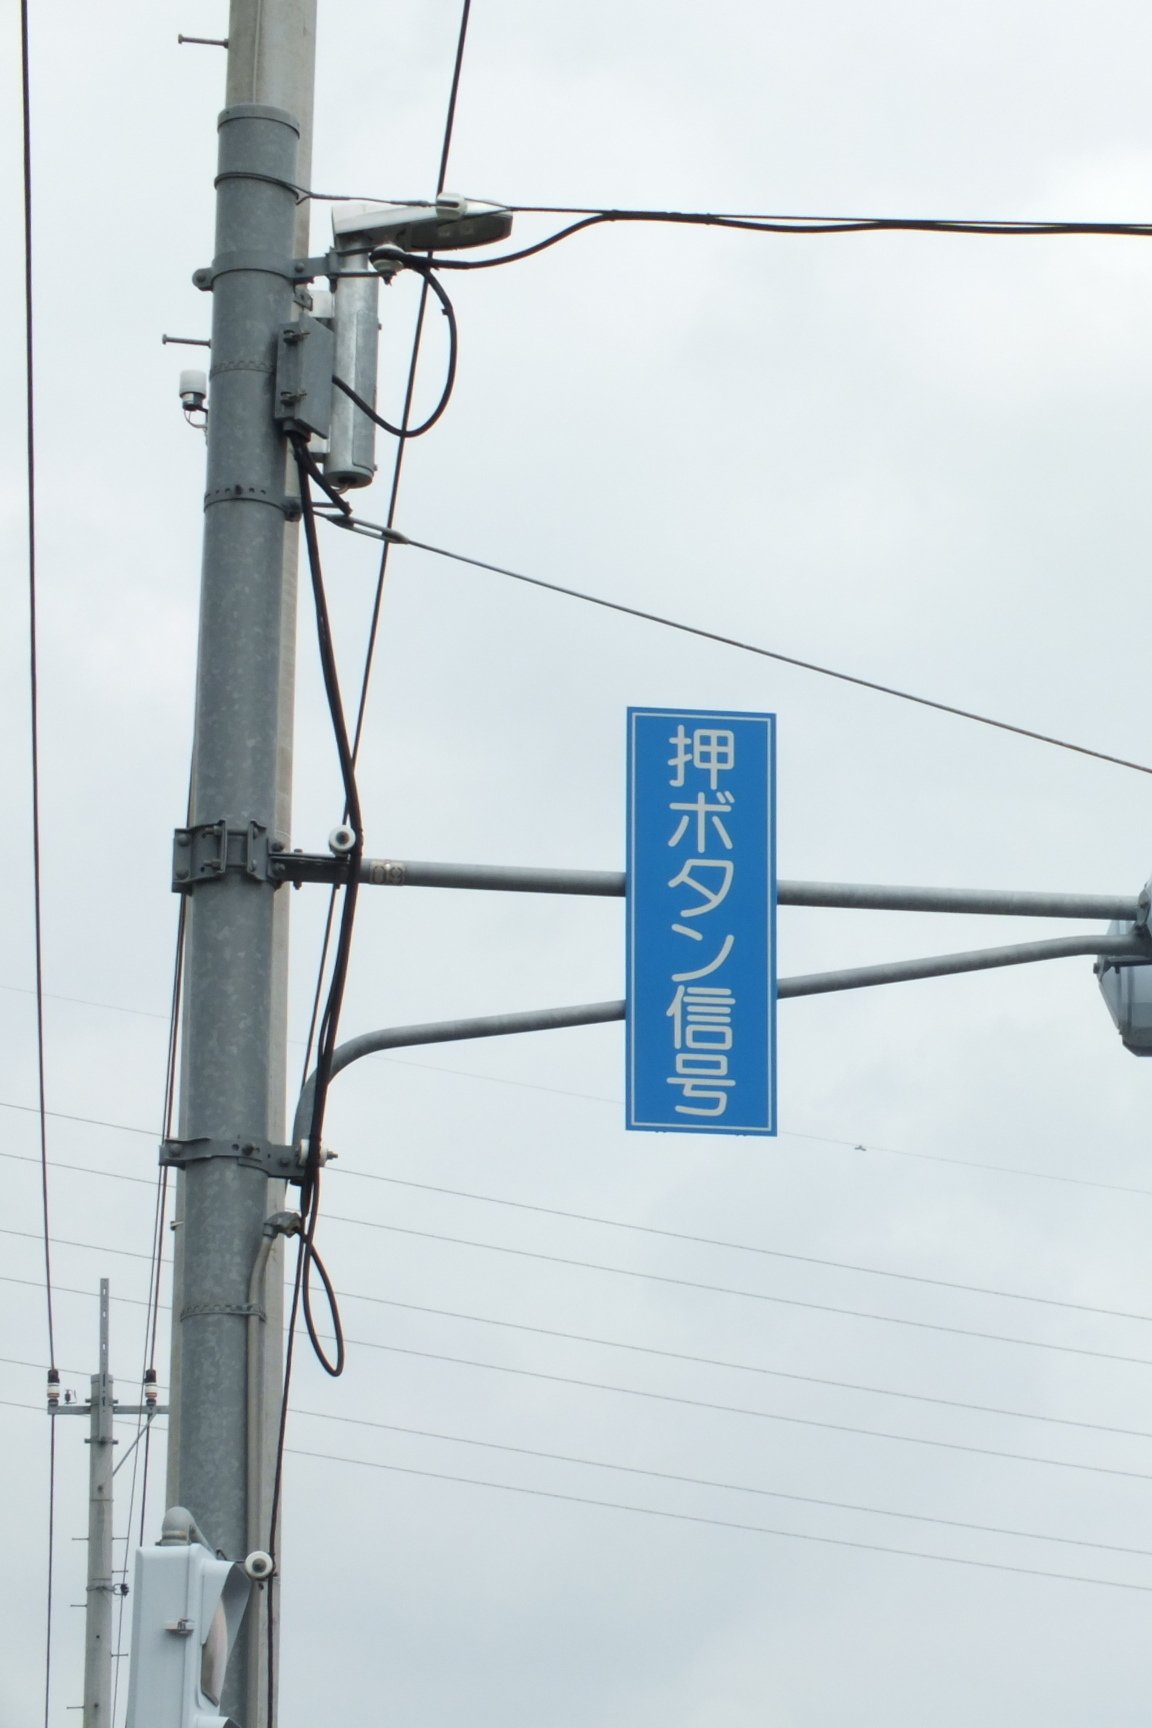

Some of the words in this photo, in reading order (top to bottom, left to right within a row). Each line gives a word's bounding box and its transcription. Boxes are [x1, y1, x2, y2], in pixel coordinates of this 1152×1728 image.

[667, 725, 735, 1116] 押ボタン信号
